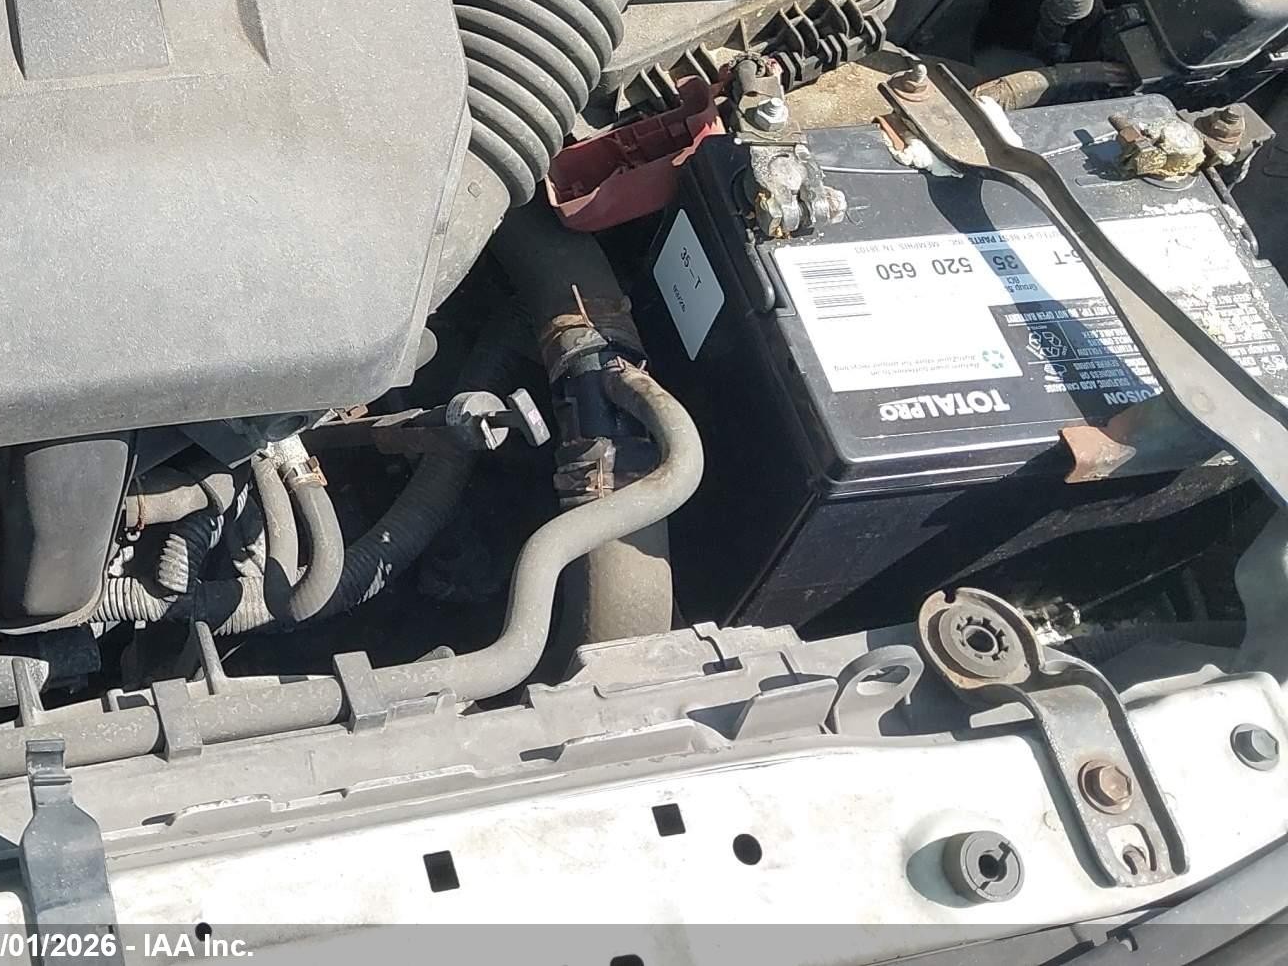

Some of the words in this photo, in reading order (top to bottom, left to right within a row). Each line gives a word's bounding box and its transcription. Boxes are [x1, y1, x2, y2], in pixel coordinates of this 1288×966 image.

[931, 257, 973, 276] 520
[992, 254, 1018, 271] 35
[875, 262, 917, 281] 650
[1037, 312, 1054, 320] OPEN
[1079, 380, 1096, 390] ACID
